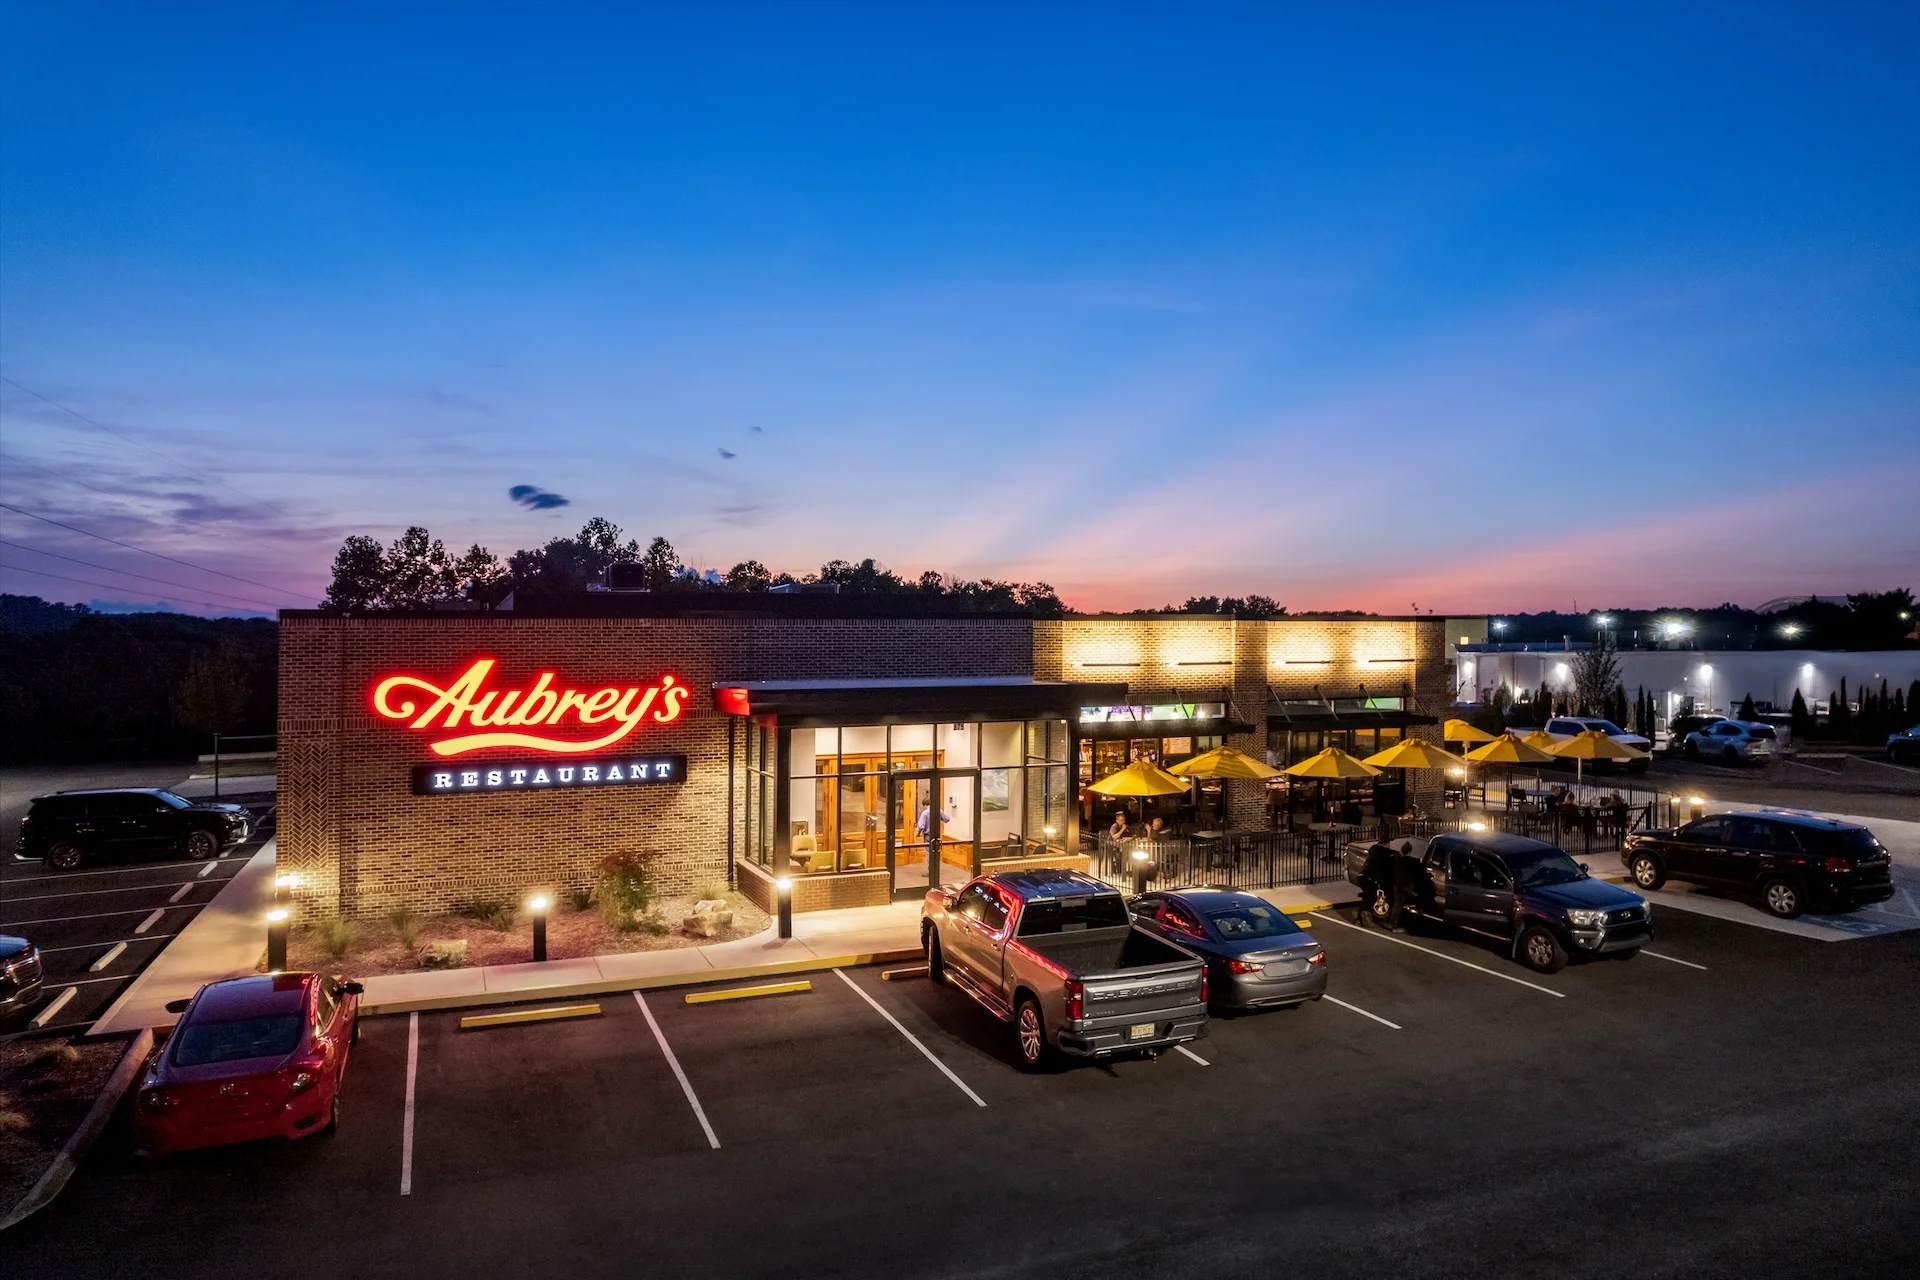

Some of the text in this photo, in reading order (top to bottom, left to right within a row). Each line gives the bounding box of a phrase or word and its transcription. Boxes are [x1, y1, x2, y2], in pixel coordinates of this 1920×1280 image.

[374, 659, 689, 756] Aubrey's
[434, 763, 671, 788] RESTAURANT
[1092, 980, 1197, 1000] CHEVROLET
